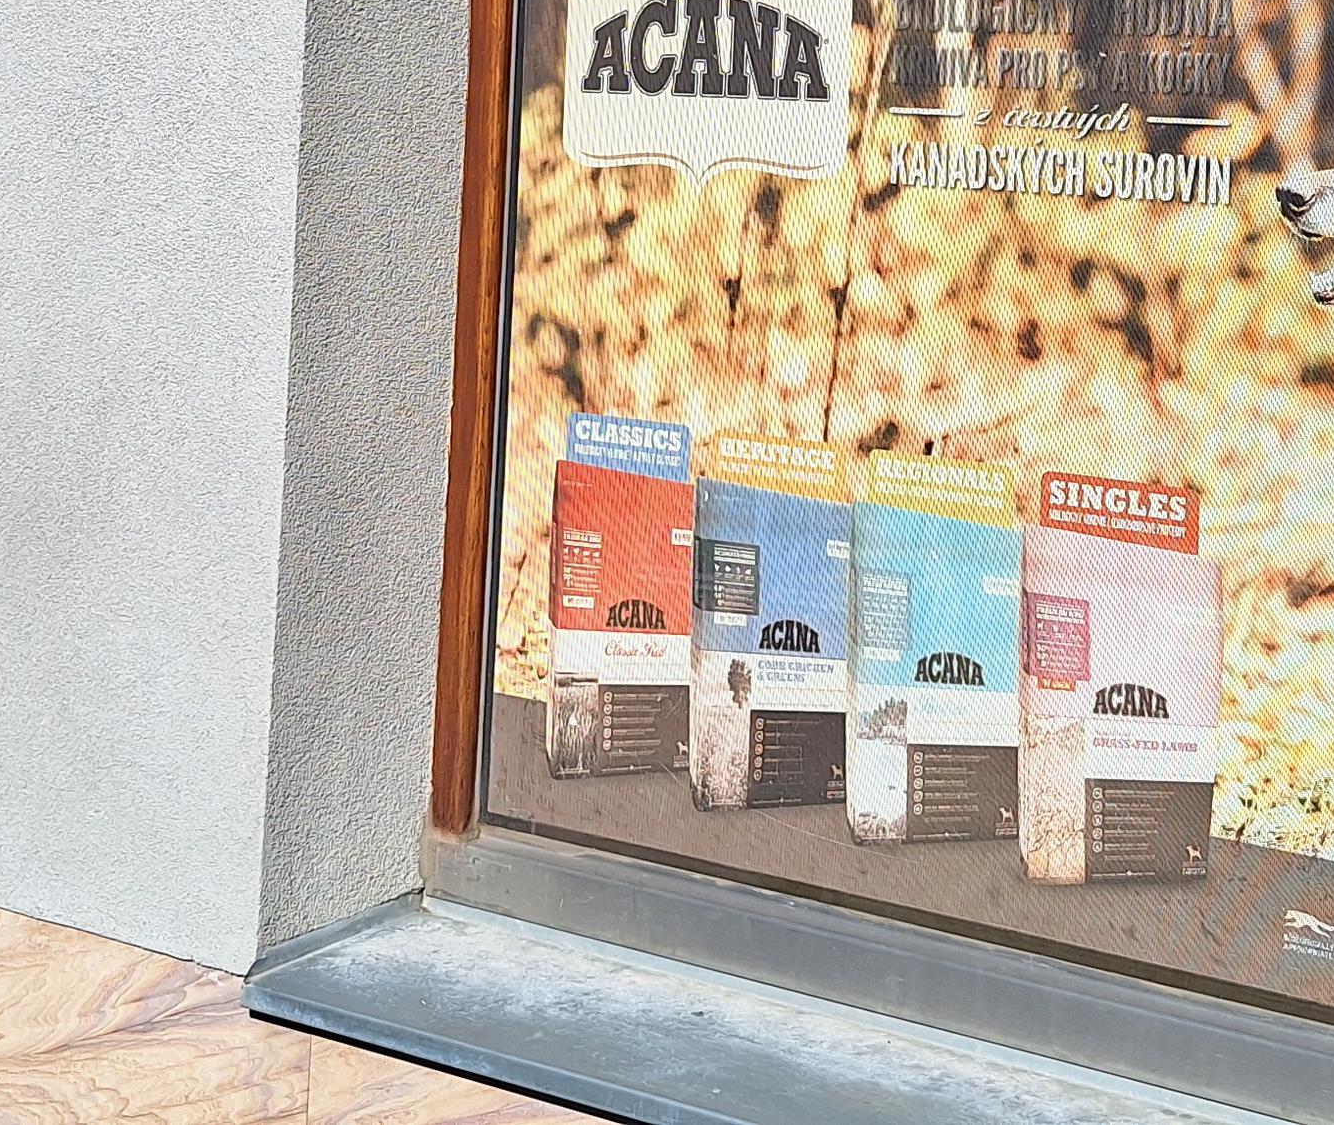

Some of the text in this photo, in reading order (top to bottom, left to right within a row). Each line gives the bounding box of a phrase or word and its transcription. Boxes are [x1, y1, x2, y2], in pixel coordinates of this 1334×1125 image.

[996, 47, 1048, 90] PRO
[1113, 50, 1131, 93] A
[973, 103, 1132, 140] z čerstvých
[888, 137, 1233, 205] KANADSKÝCH SUROVIN
[575, 419, 683, 452] CLASSICS
[719, 437, 835, 471] HERITAGE
[877, 457, 1004, 492] REGIONALS
[1049, 479, 1188, 522] SINGLES
[606, 598, 667, 630] ACANA
[758, 619, 821, 654] ACANA
[913, 651, 986, 687] ACANA
[1092, 682, 1170, 719] ACANA
